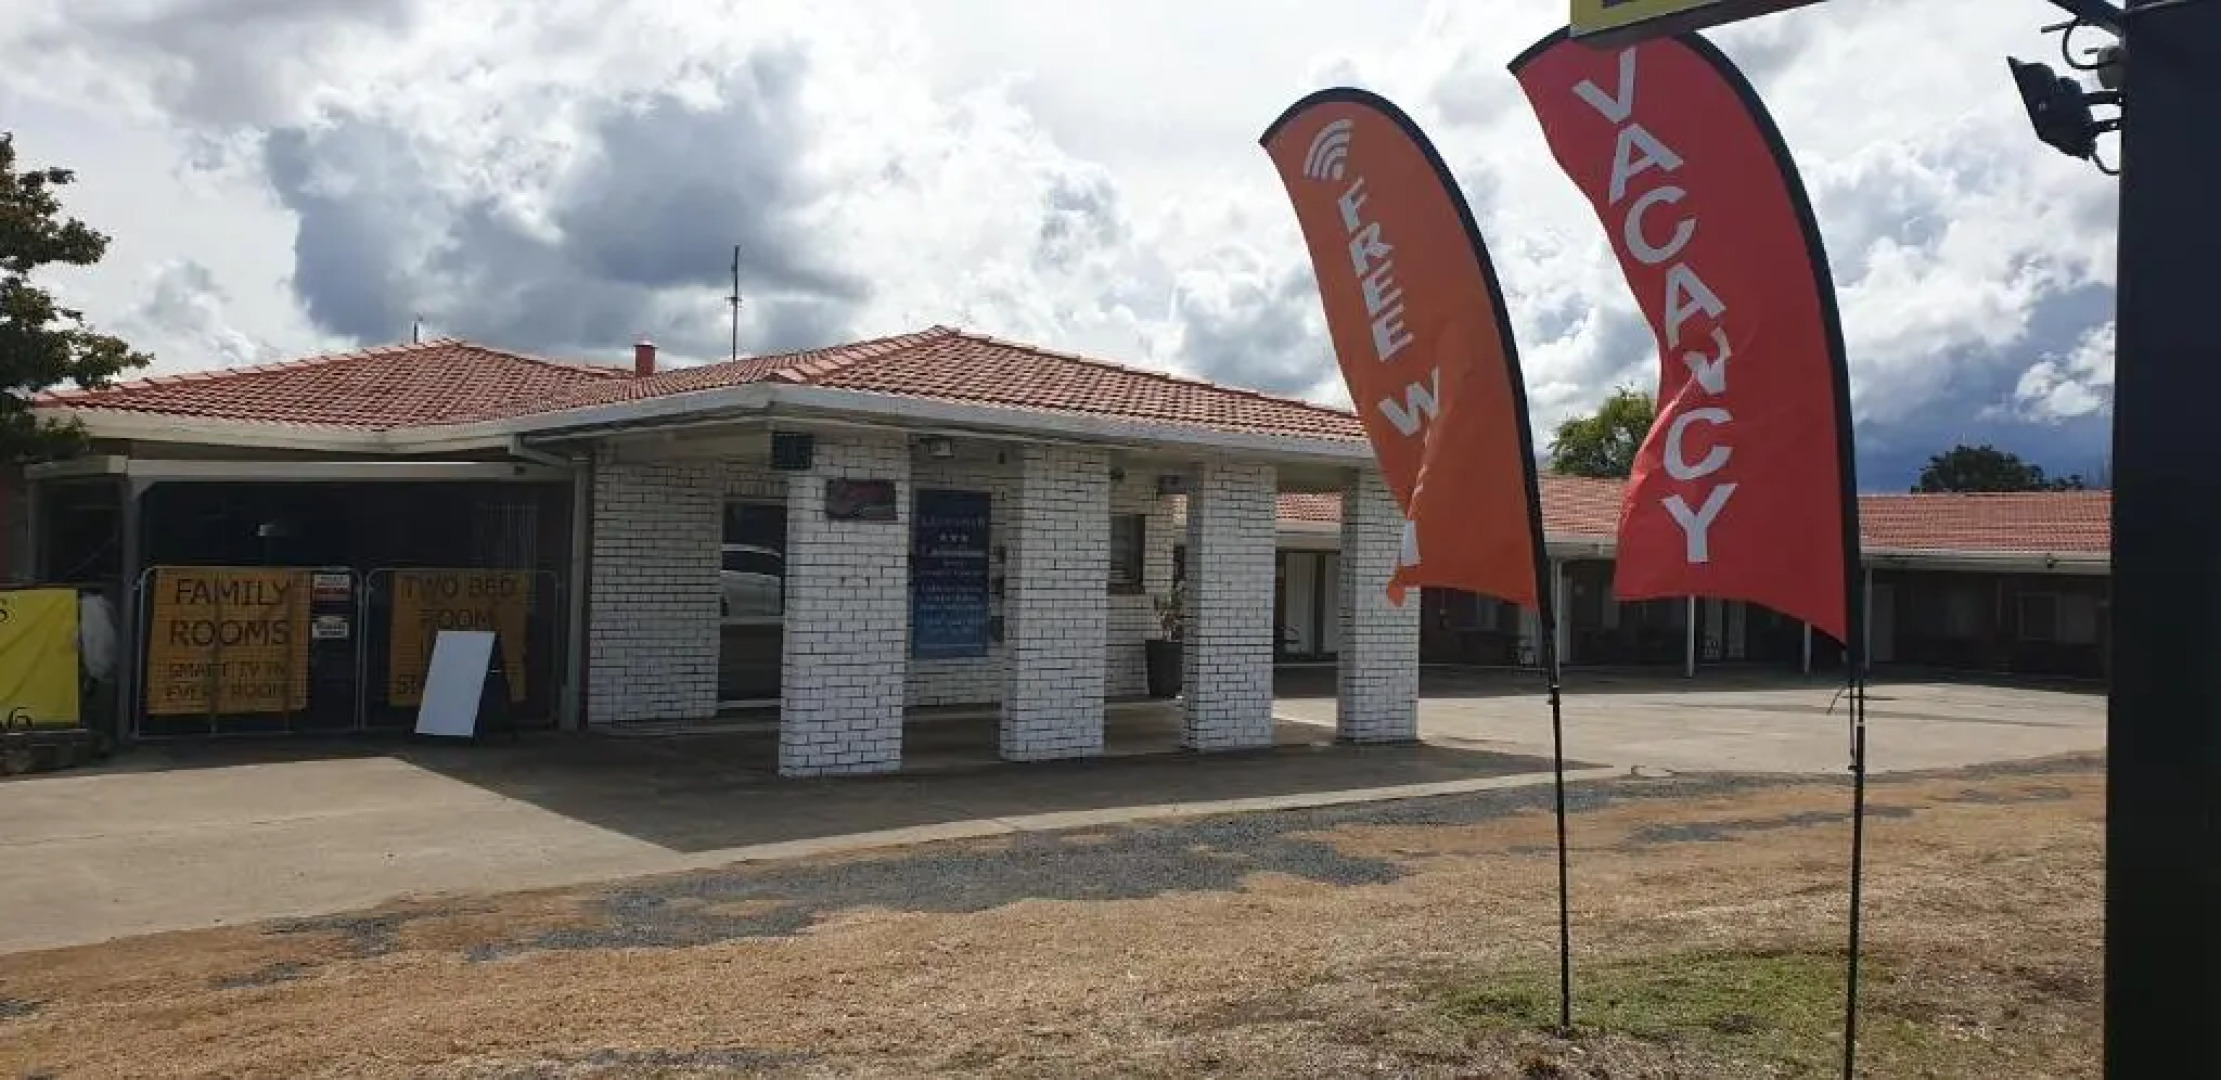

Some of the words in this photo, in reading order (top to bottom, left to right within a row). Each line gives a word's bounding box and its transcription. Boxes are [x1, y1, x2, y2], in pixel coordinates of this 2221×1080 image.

[1338, 177, 1412, 362] FREE
[1573, 46, 1736, 564] VACANCY
[175, 578, 291, 605] FAMILY
[401, 573, 458, 598] TWO
[468, 573, 517, 598] BED
[169, 620, 290, 646] ROOMS
